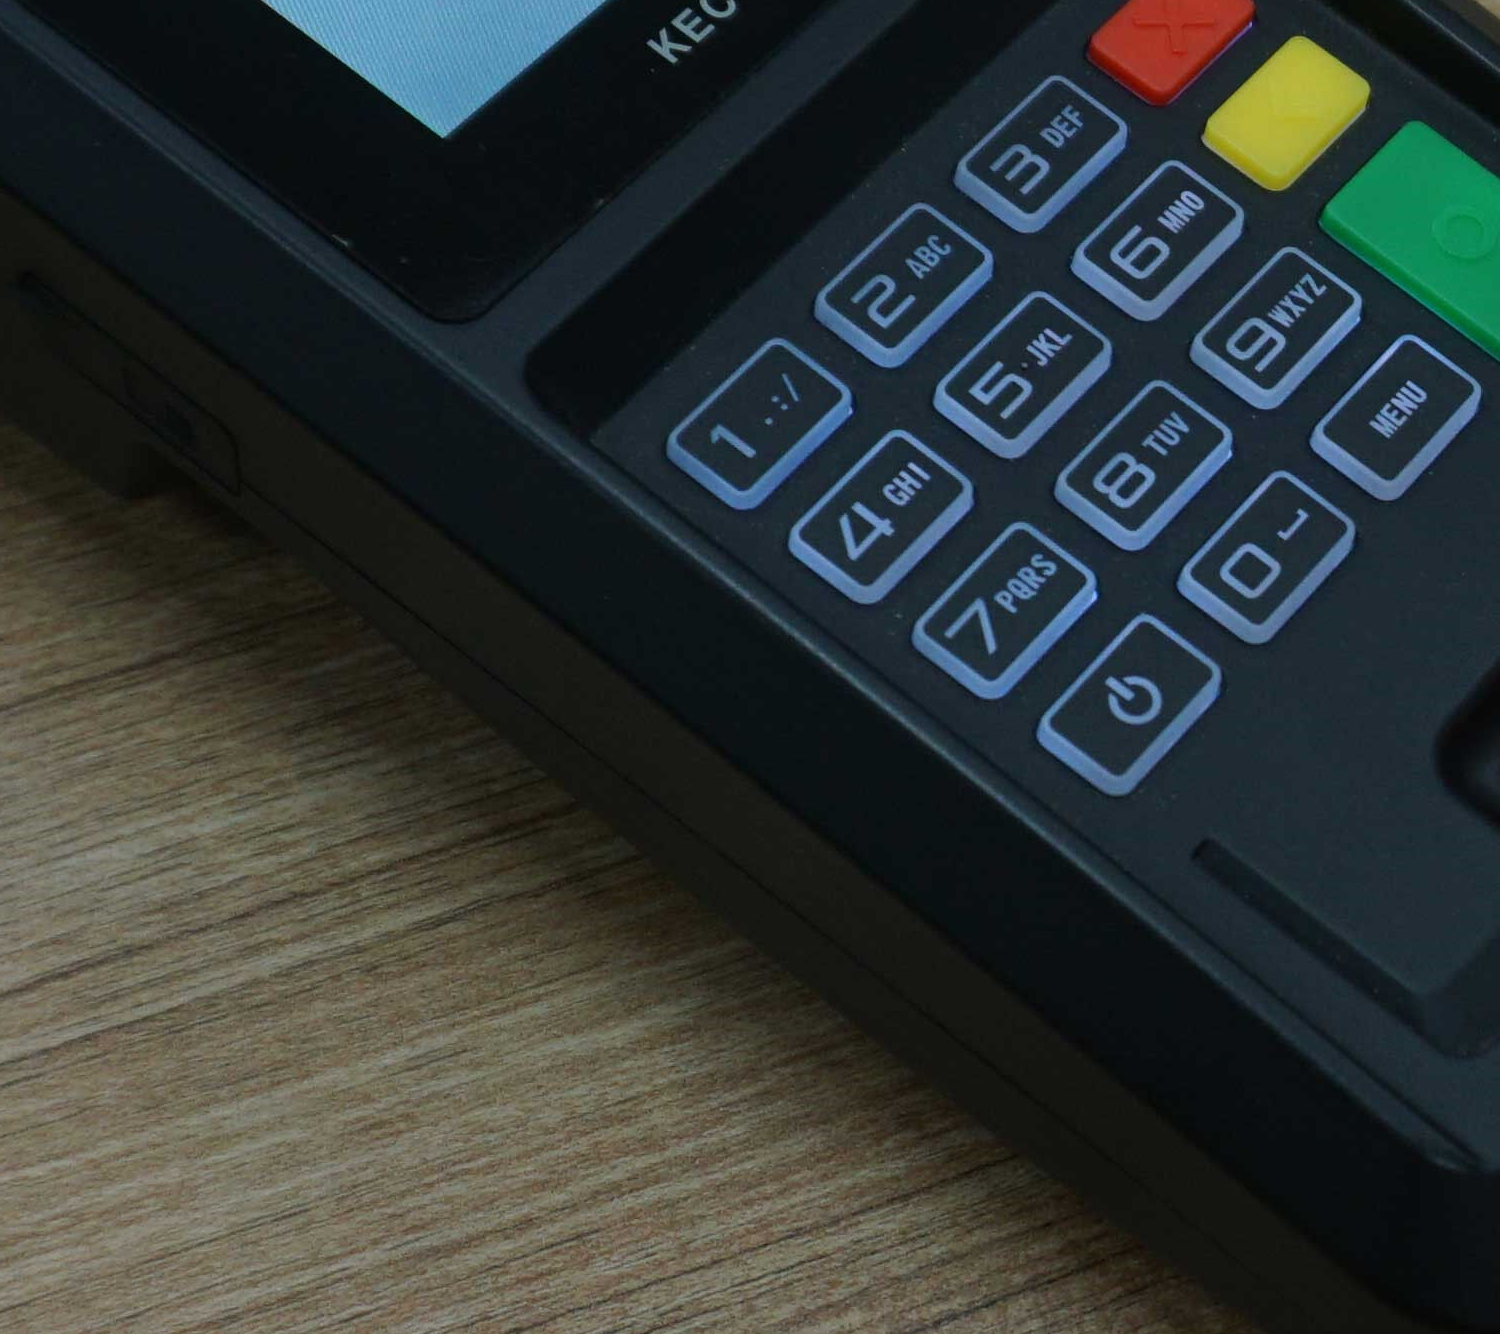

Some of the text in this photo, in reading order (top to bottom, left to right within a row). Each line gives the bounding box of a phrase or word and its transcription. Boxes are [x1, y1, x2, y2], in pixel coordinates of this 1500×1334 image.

[989, 104, 1086, 195] 3 DEF
[851, 234, 953, 330] 2 ABC
[1110, 190, 1206, 281] 6 MNO
[1227, 273, 1328, 373] 9 WXYZ
[968, 327, 1072, 420] 5 JKL
[1369, 380, 1428, 439] MENU
[710, 422, 757, 460] 1
[1094, 410, 1192, 509] 8 TUV
[838, 462, 931, 561] 4 GHI
[944, 552, 1058, 656] 7 PQRS
